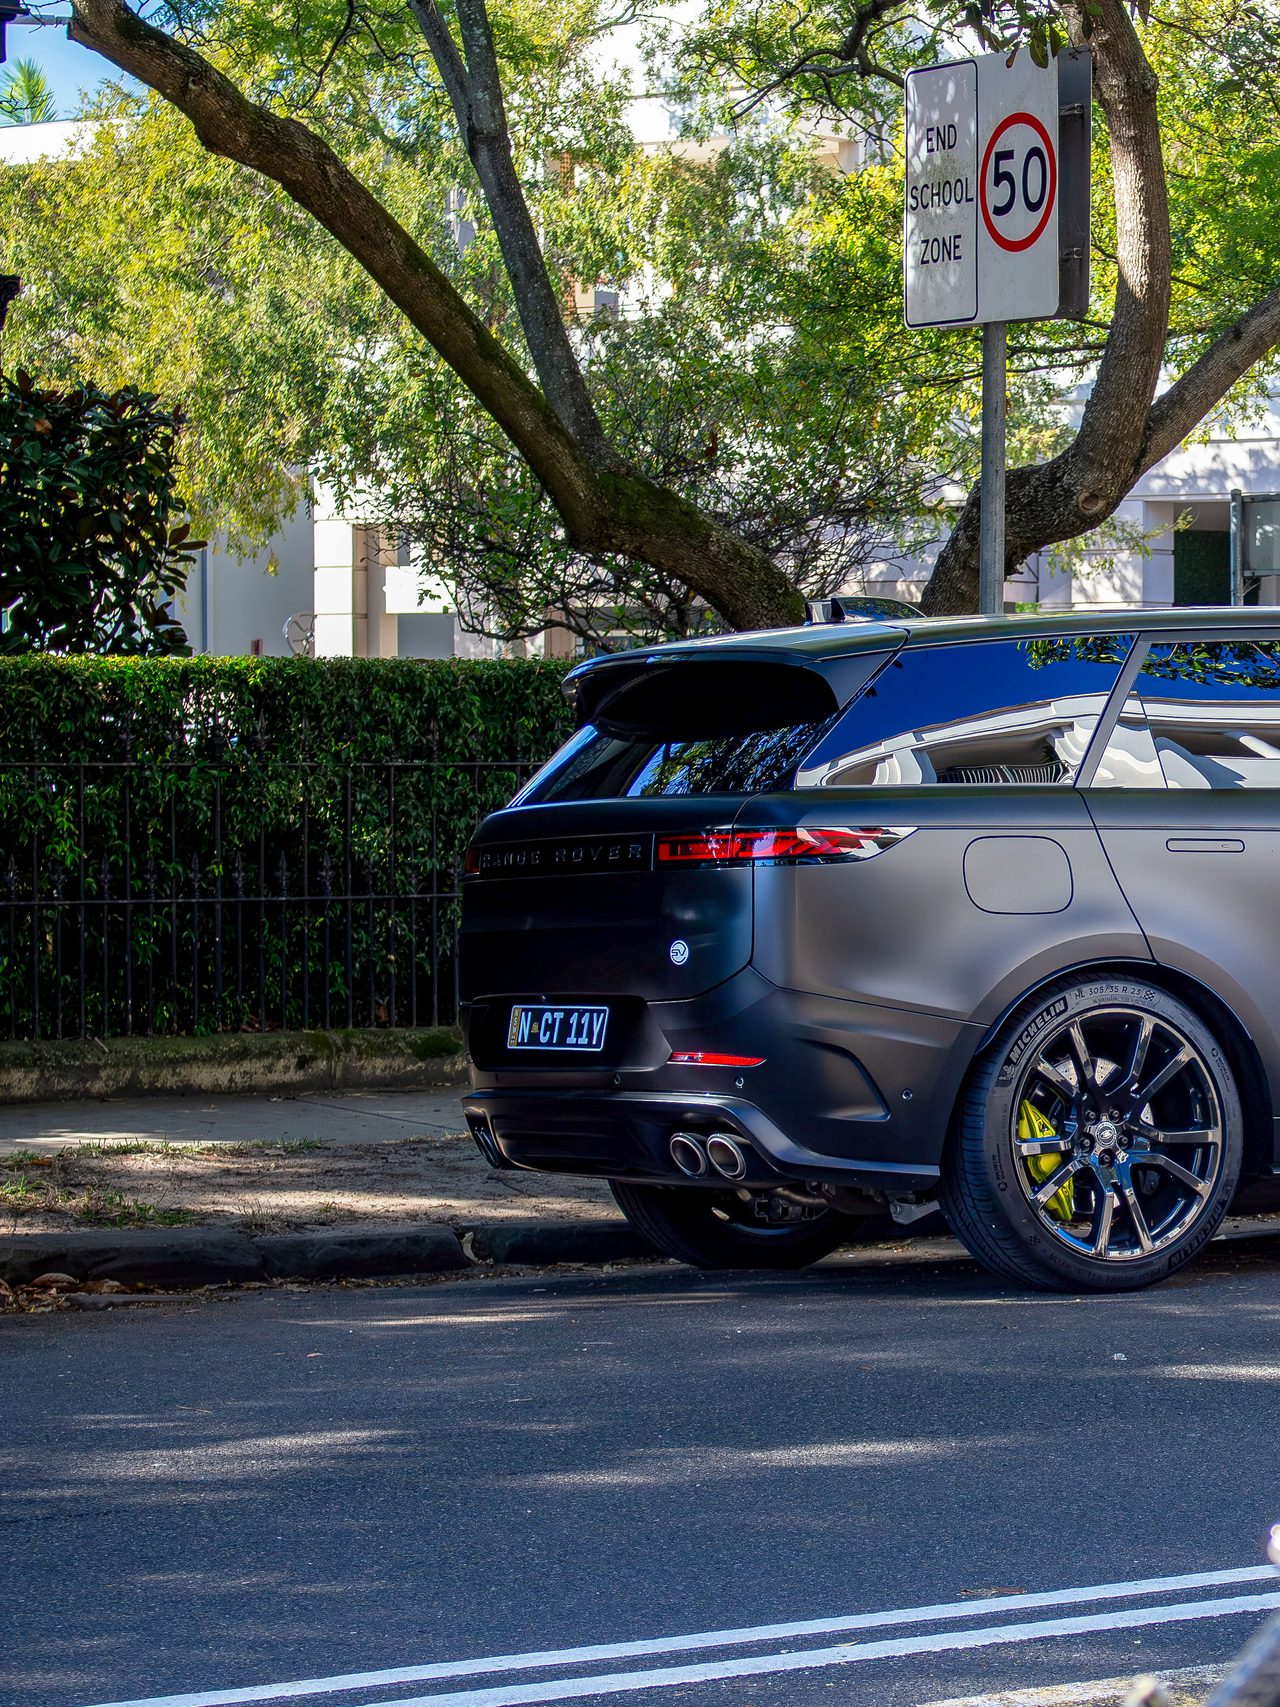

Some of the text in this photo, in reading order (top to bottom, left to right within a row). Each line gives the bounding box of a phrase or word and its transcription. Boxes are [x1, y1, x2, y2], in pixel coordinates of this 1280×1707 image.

[926, 123, 957, 153] END
[910, 177, 974, 212] SCHOOL
[992, 146, 1048, 216] 50
[920, 234, 962, 265] ZONE
[482, 844, 642, 868] RANGE ROVER
[1075, 991, 1085, 1000] HL
[1089, 985, 1119, 996] 305/35
[1130, 987, 1141, 996] 23
[540, 1011, 565, 1044] CT
[566, 1012, 605, 1045] 11Y
[1009, 1000, 1065, 1063] MICHELIN
